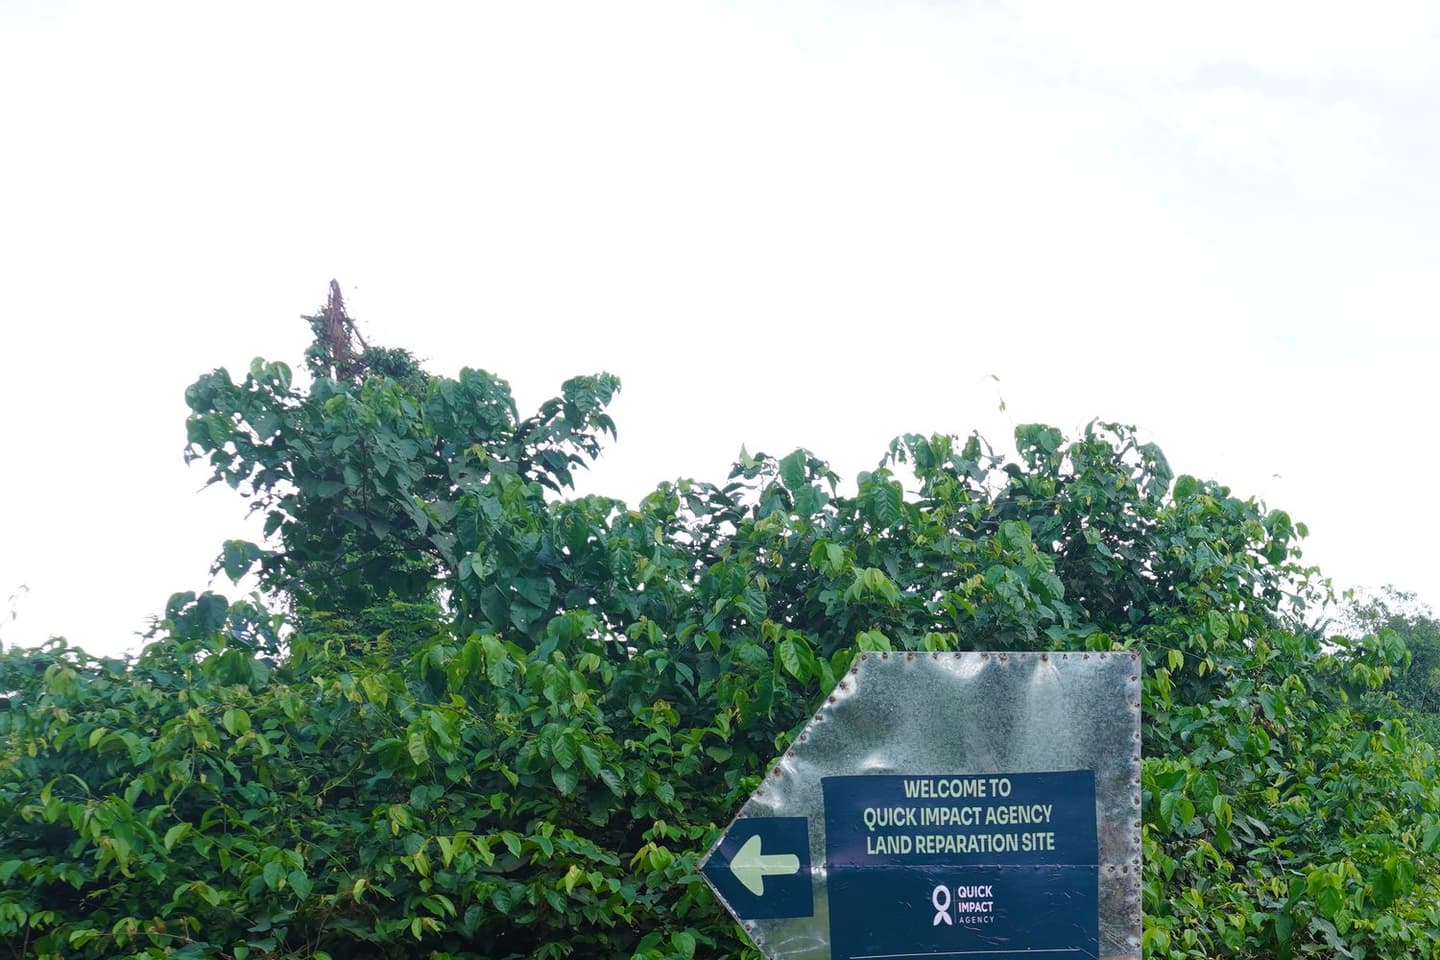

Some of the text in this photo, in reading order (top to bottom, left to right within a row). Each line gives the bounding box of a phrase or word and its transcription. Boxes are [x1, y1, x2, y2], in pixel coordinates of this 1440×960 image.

[904, 778, 1011, 799] WELCOME TO
[863, 804, 1052, 831] QUICK IMPACT AGENCY
[867, 832, 1055, 855] LAND REPARATION SITE
[958, 885, 993, 898] QUICK
[958, 901, 994, 913] IMPACT
[959, 916, 995, 924] AGENCY
